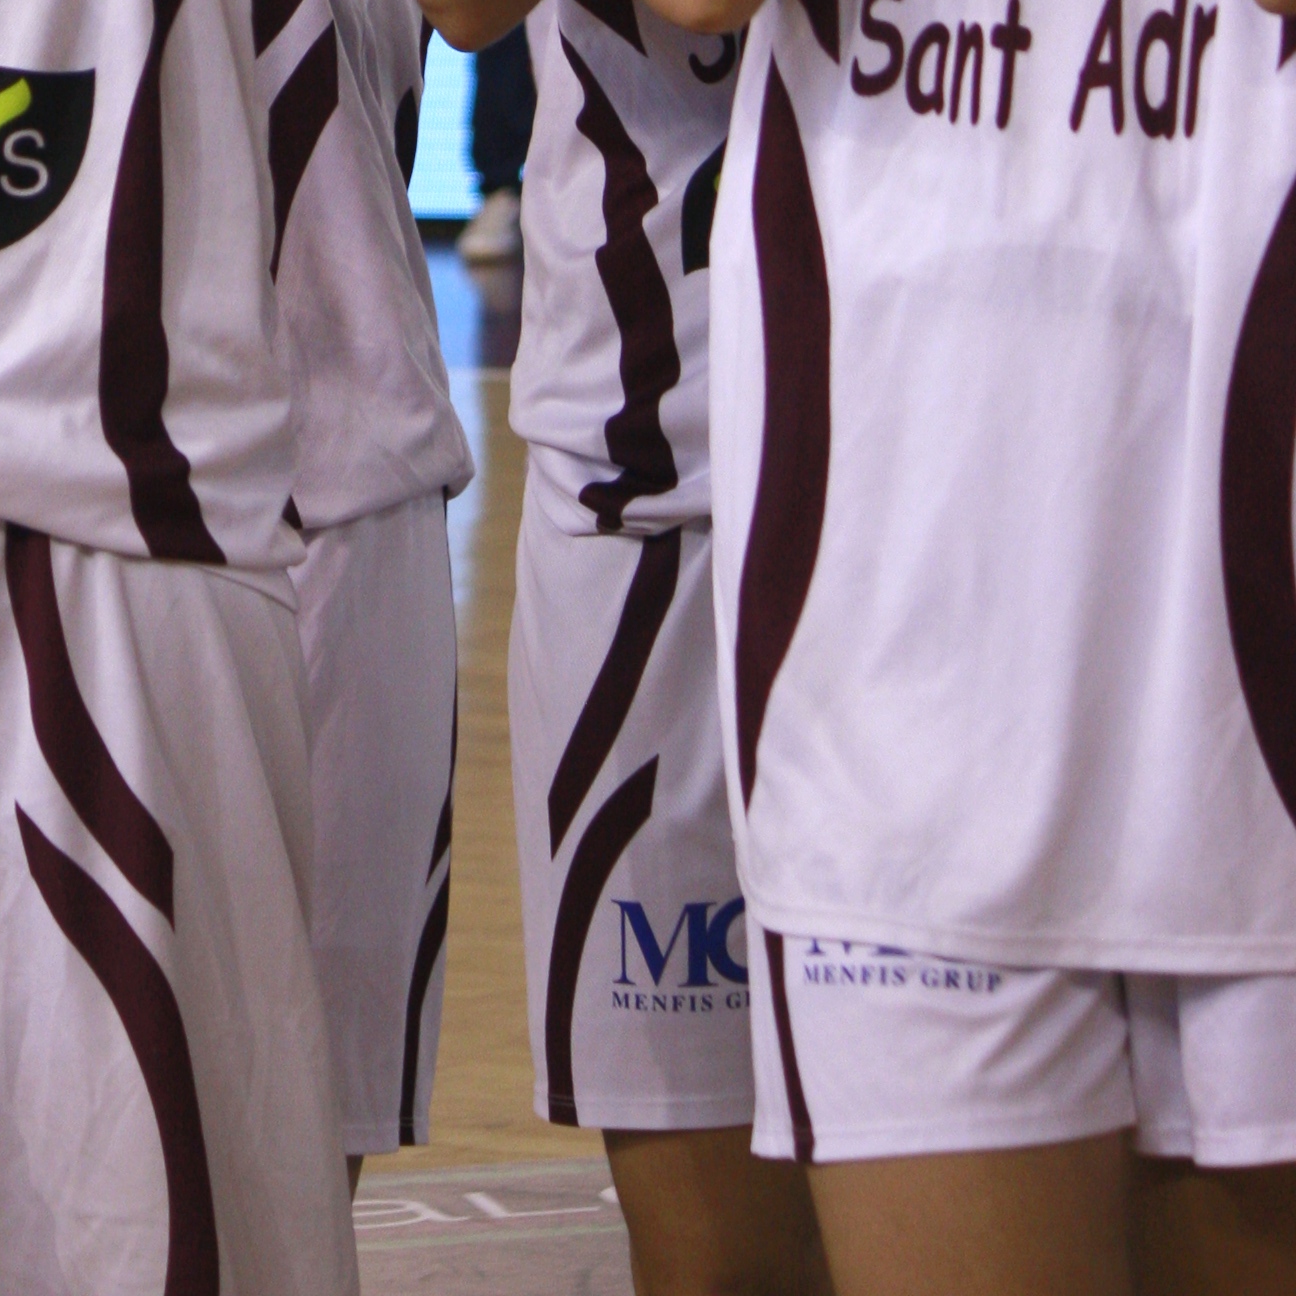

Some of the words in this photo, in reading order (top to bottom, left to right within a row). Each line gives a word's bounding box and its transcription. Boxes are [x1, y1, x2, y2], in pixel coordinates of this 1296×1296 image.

[804, 964, 907, 986] MENFIS
[921, 964, 1003, 993] GRUP
[612, 991, 718, 1013] MENFIS
